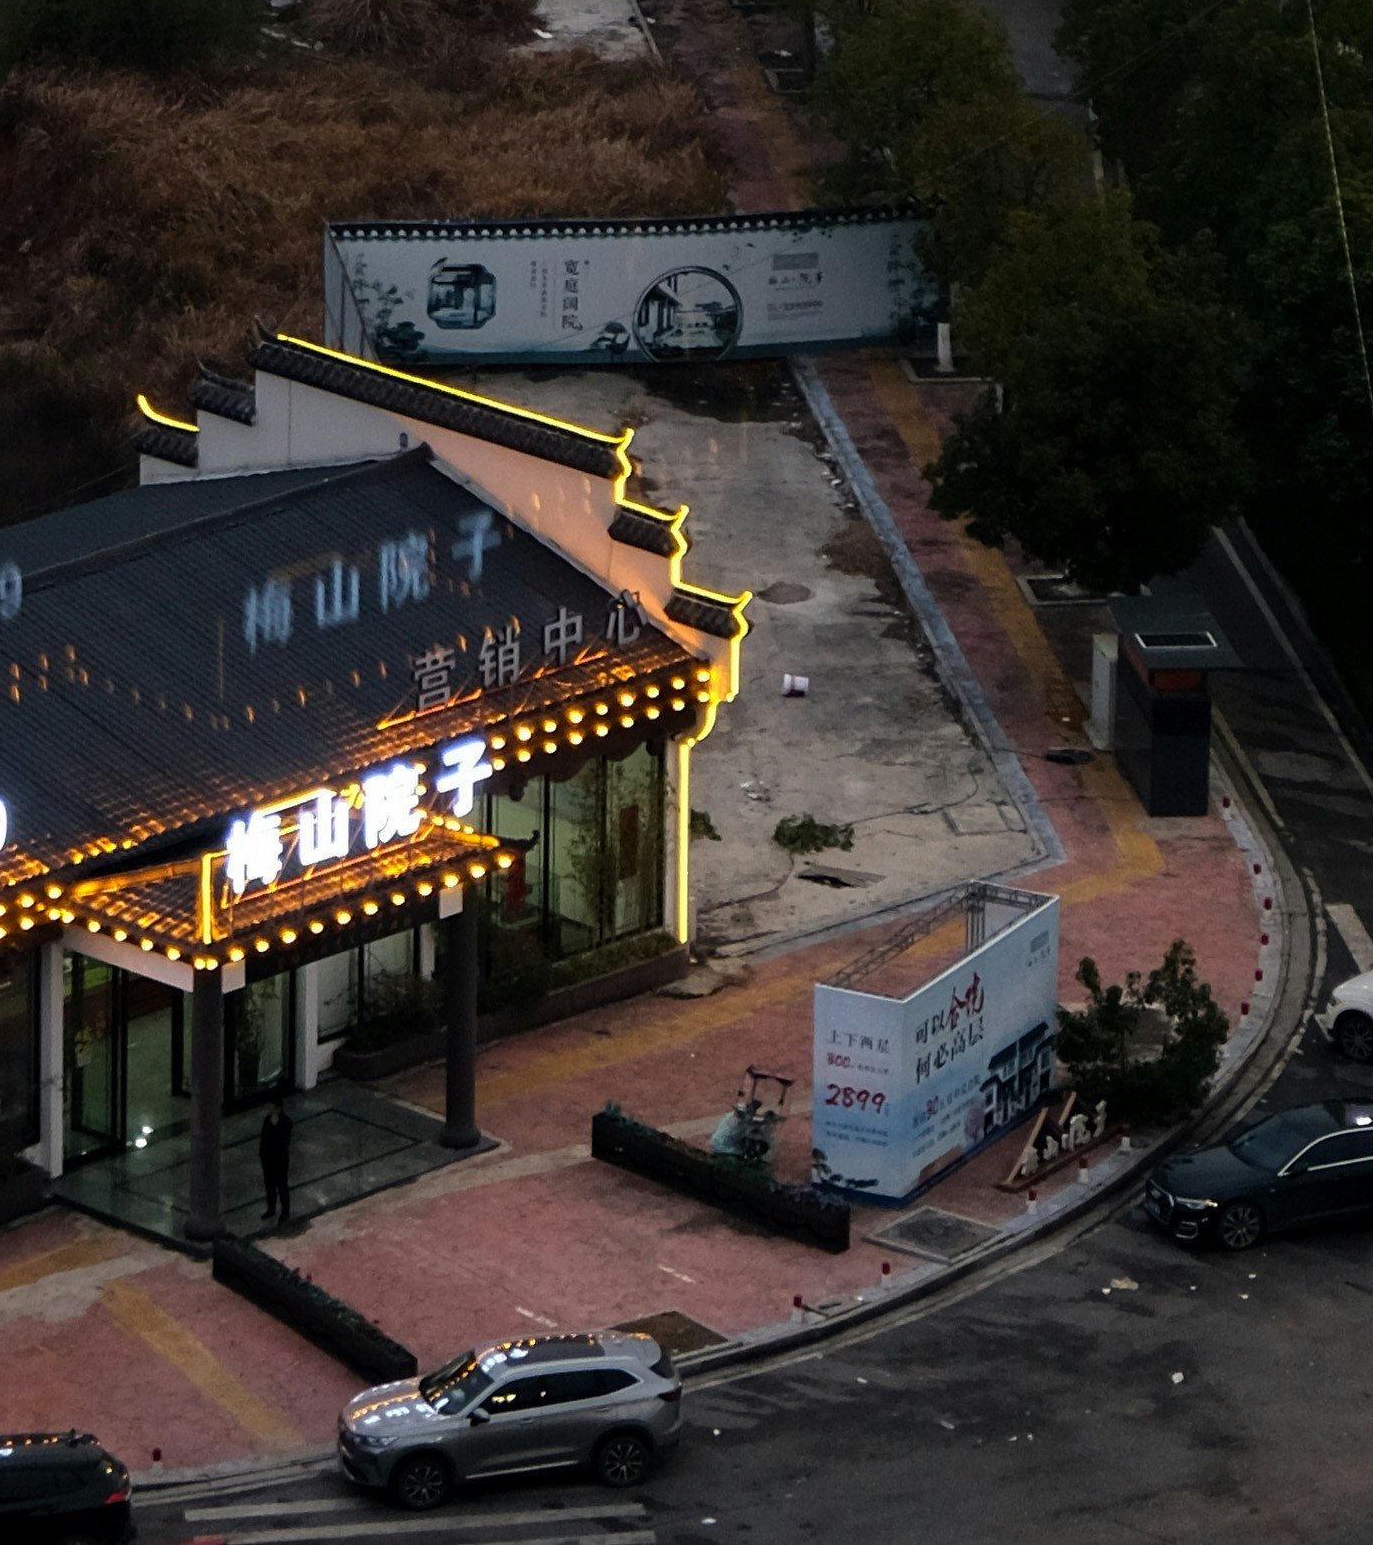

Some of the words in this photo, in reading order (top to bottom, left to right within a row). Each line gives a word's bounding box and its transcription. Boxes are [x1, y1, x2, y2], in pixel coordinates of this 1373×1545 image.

[414, 588, 648, 711] 营销中心
[225, 738, 494, 895] 梅山院子
[825, 1082, 887, 1115] 2899
